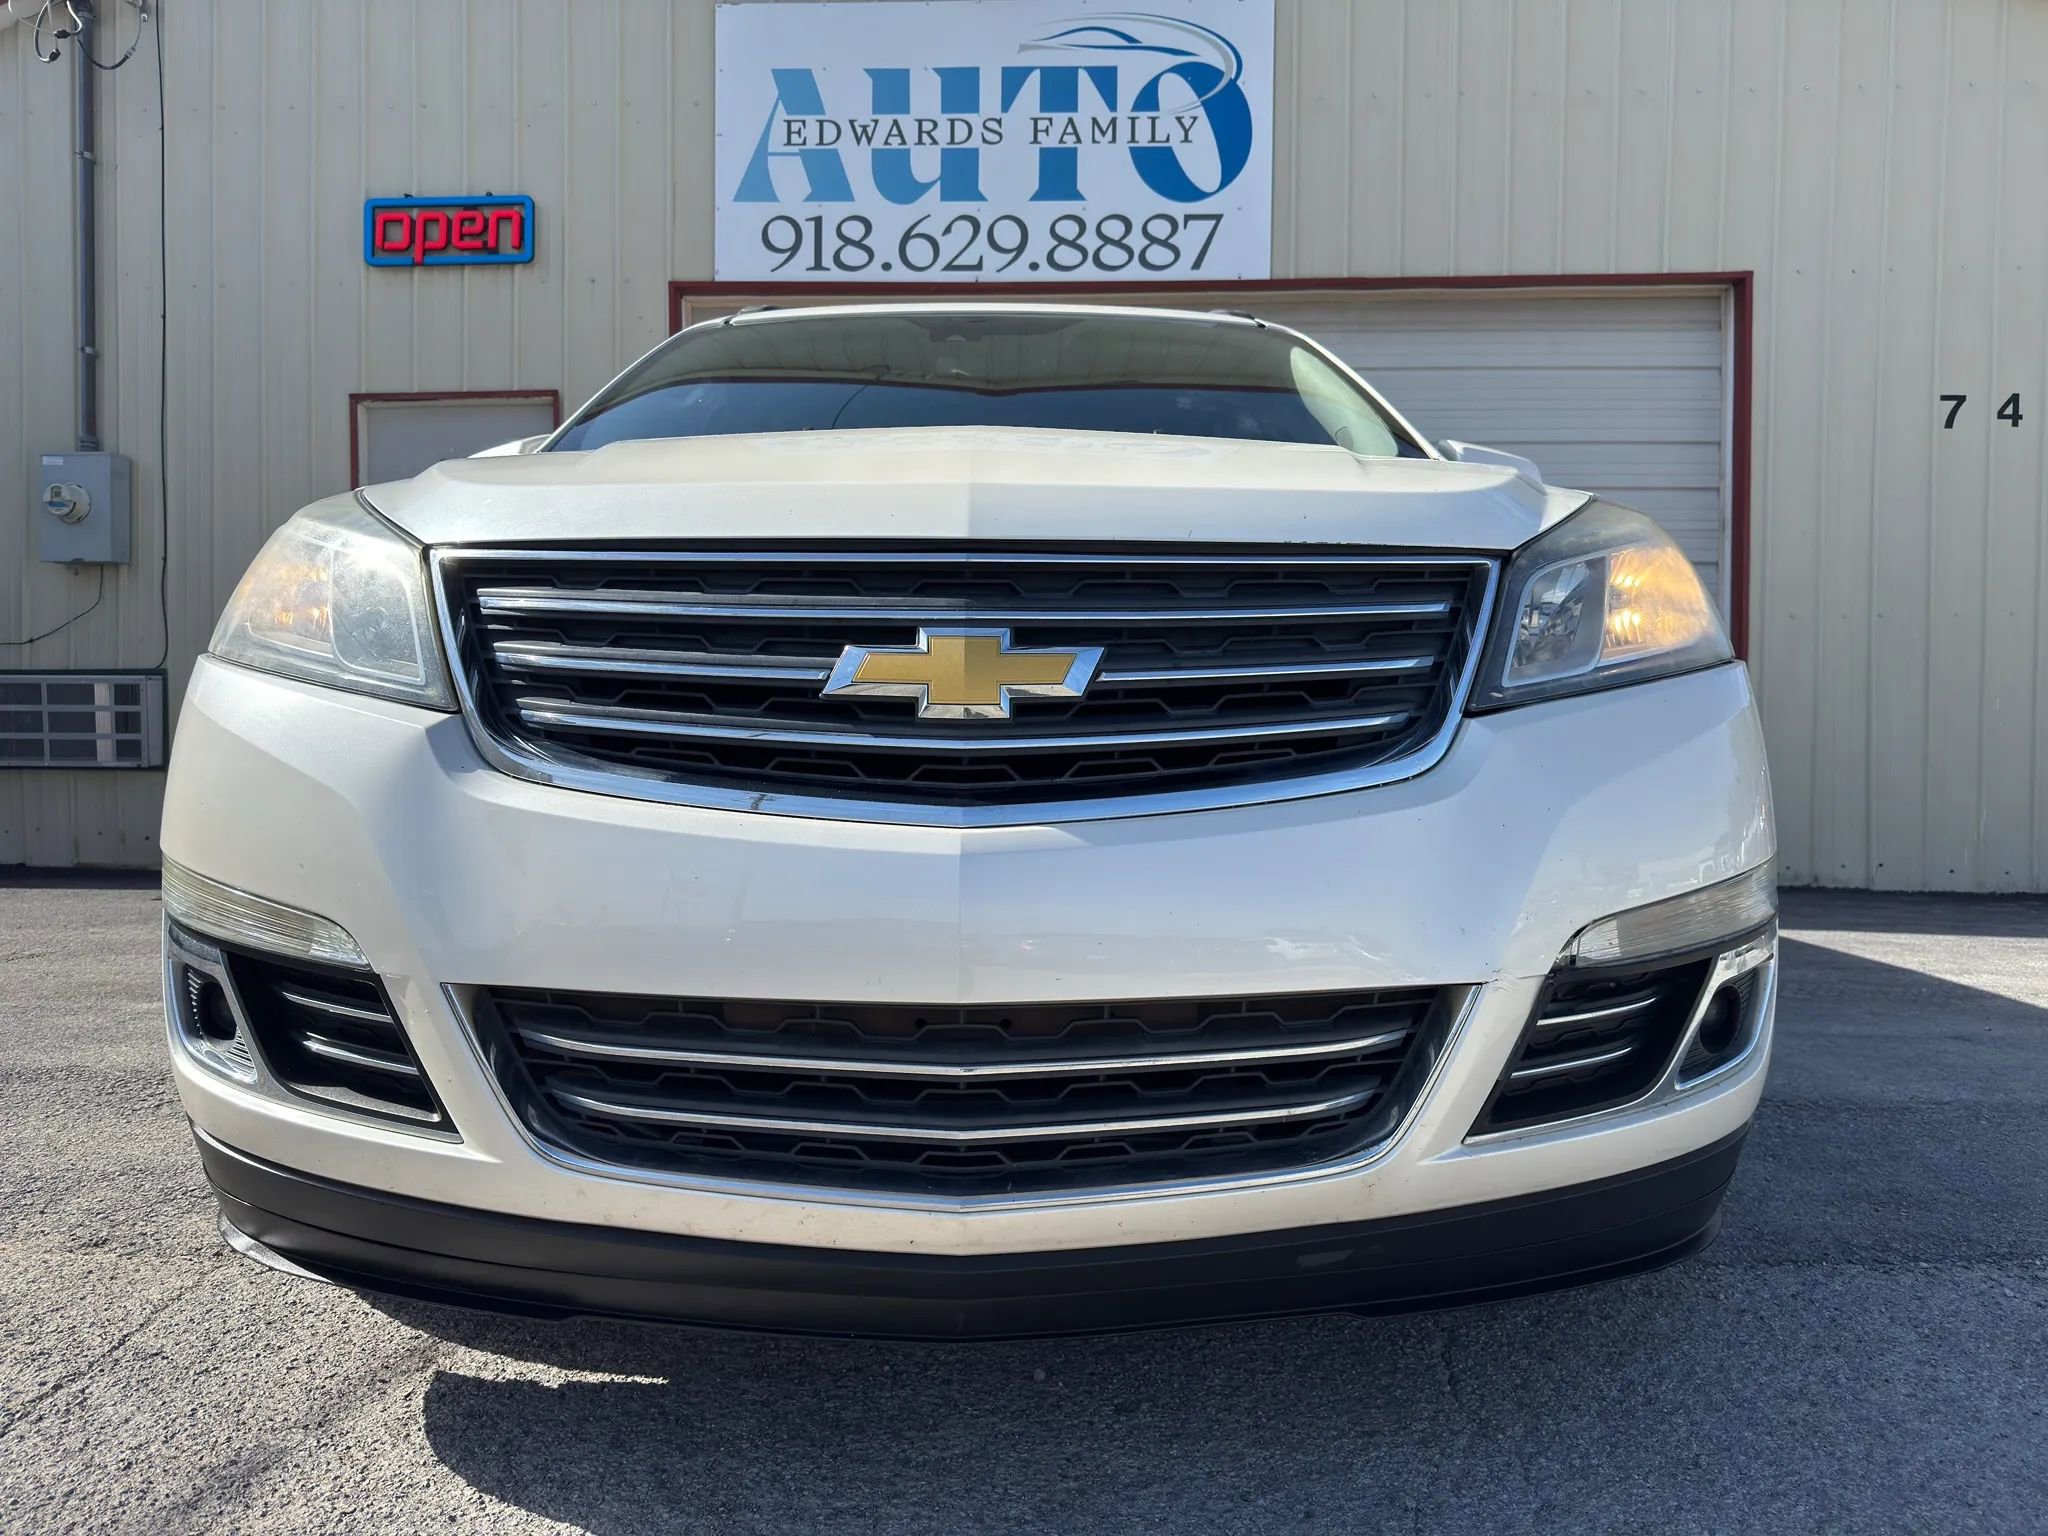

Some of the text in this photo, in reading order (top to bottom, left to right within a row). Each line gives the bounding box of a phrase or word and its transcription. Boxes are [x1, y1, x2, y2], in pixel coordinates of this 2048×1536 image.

[783, 115, 1200, 147] EDWARDS FAMILY
[761, 213, 1225, 273] 918.629.8887
